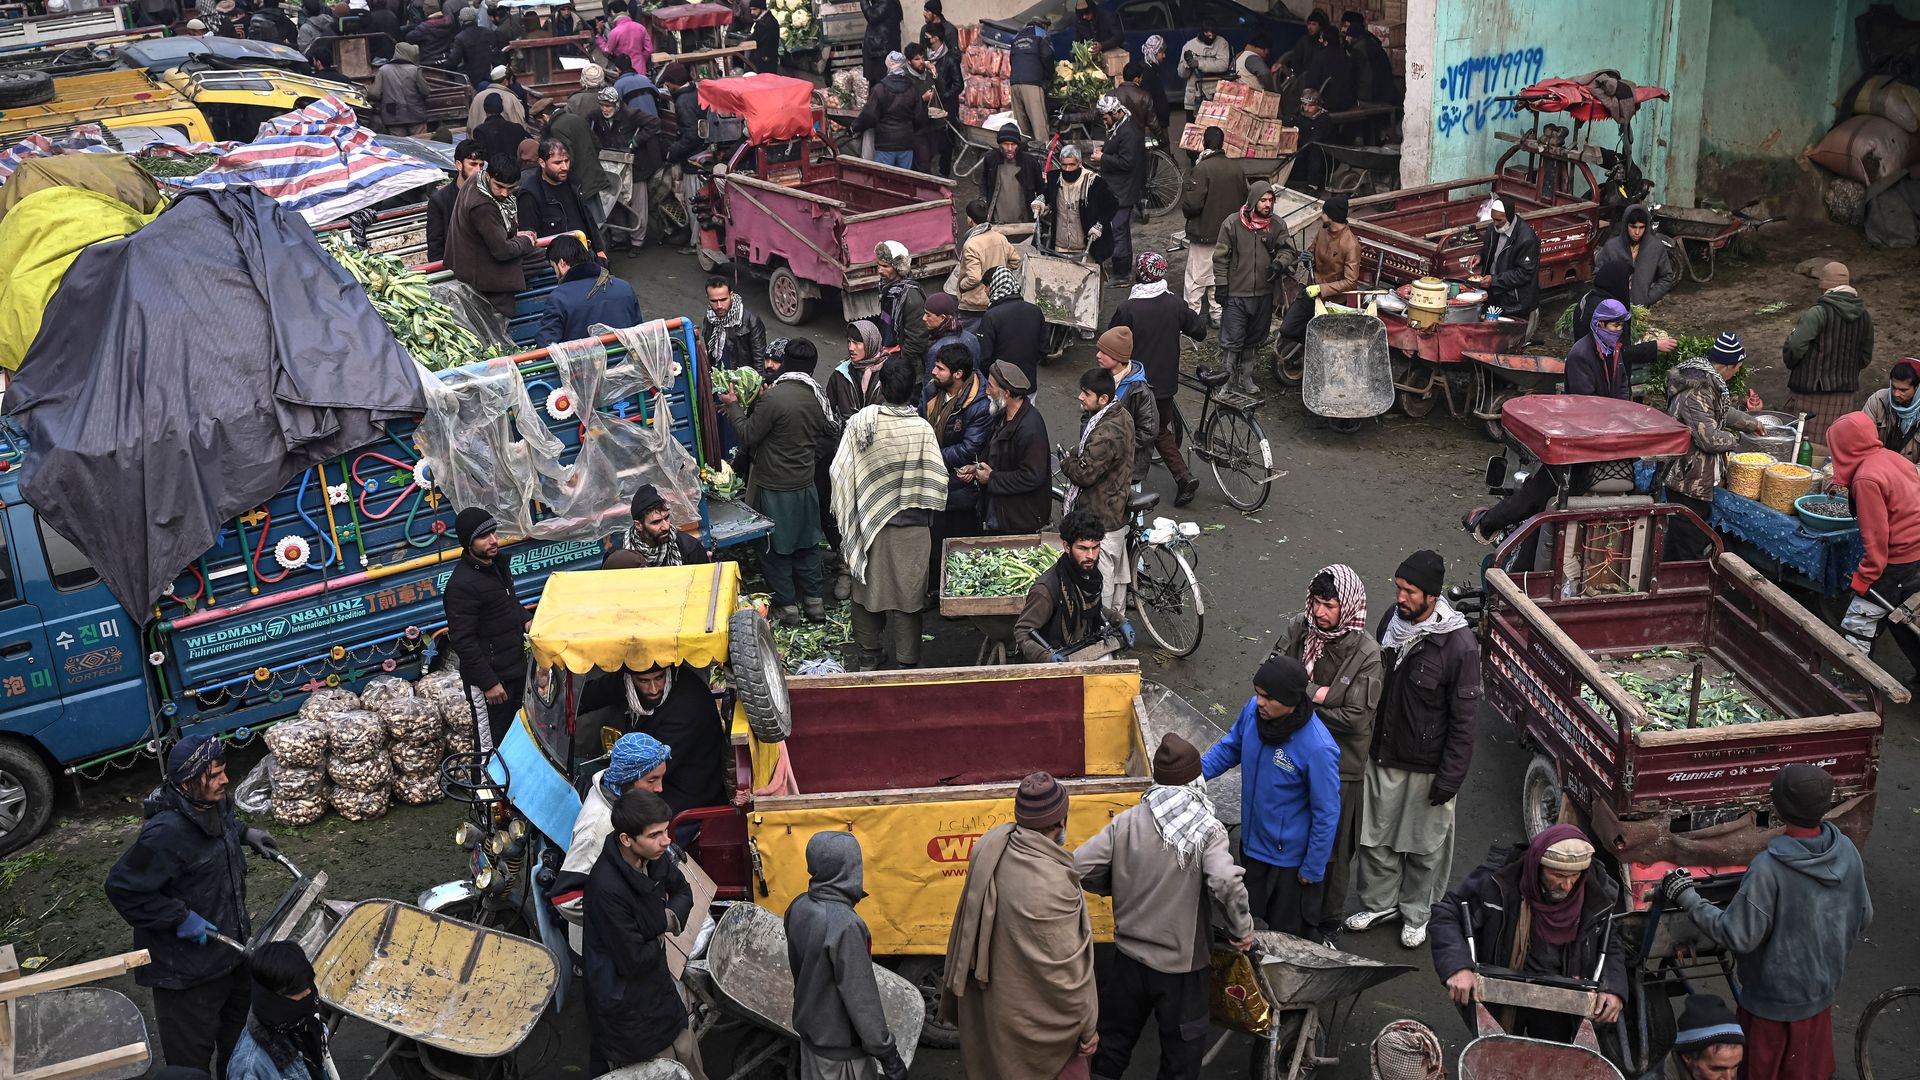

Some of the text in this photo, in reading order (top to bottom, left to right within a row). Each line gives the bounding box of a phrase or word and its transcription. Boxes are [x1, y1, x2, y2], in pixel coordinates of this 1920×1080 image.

[532, 546, 601, 570] STICKERS
[186, 597, 364, 648] WIEDMAN N&WINZ
[291, 608, 366, 634] Internationale Spedition
[189, 635, 267, 659] Fuhrunternehmen
[68, 665, 122, 684] VORTECH
